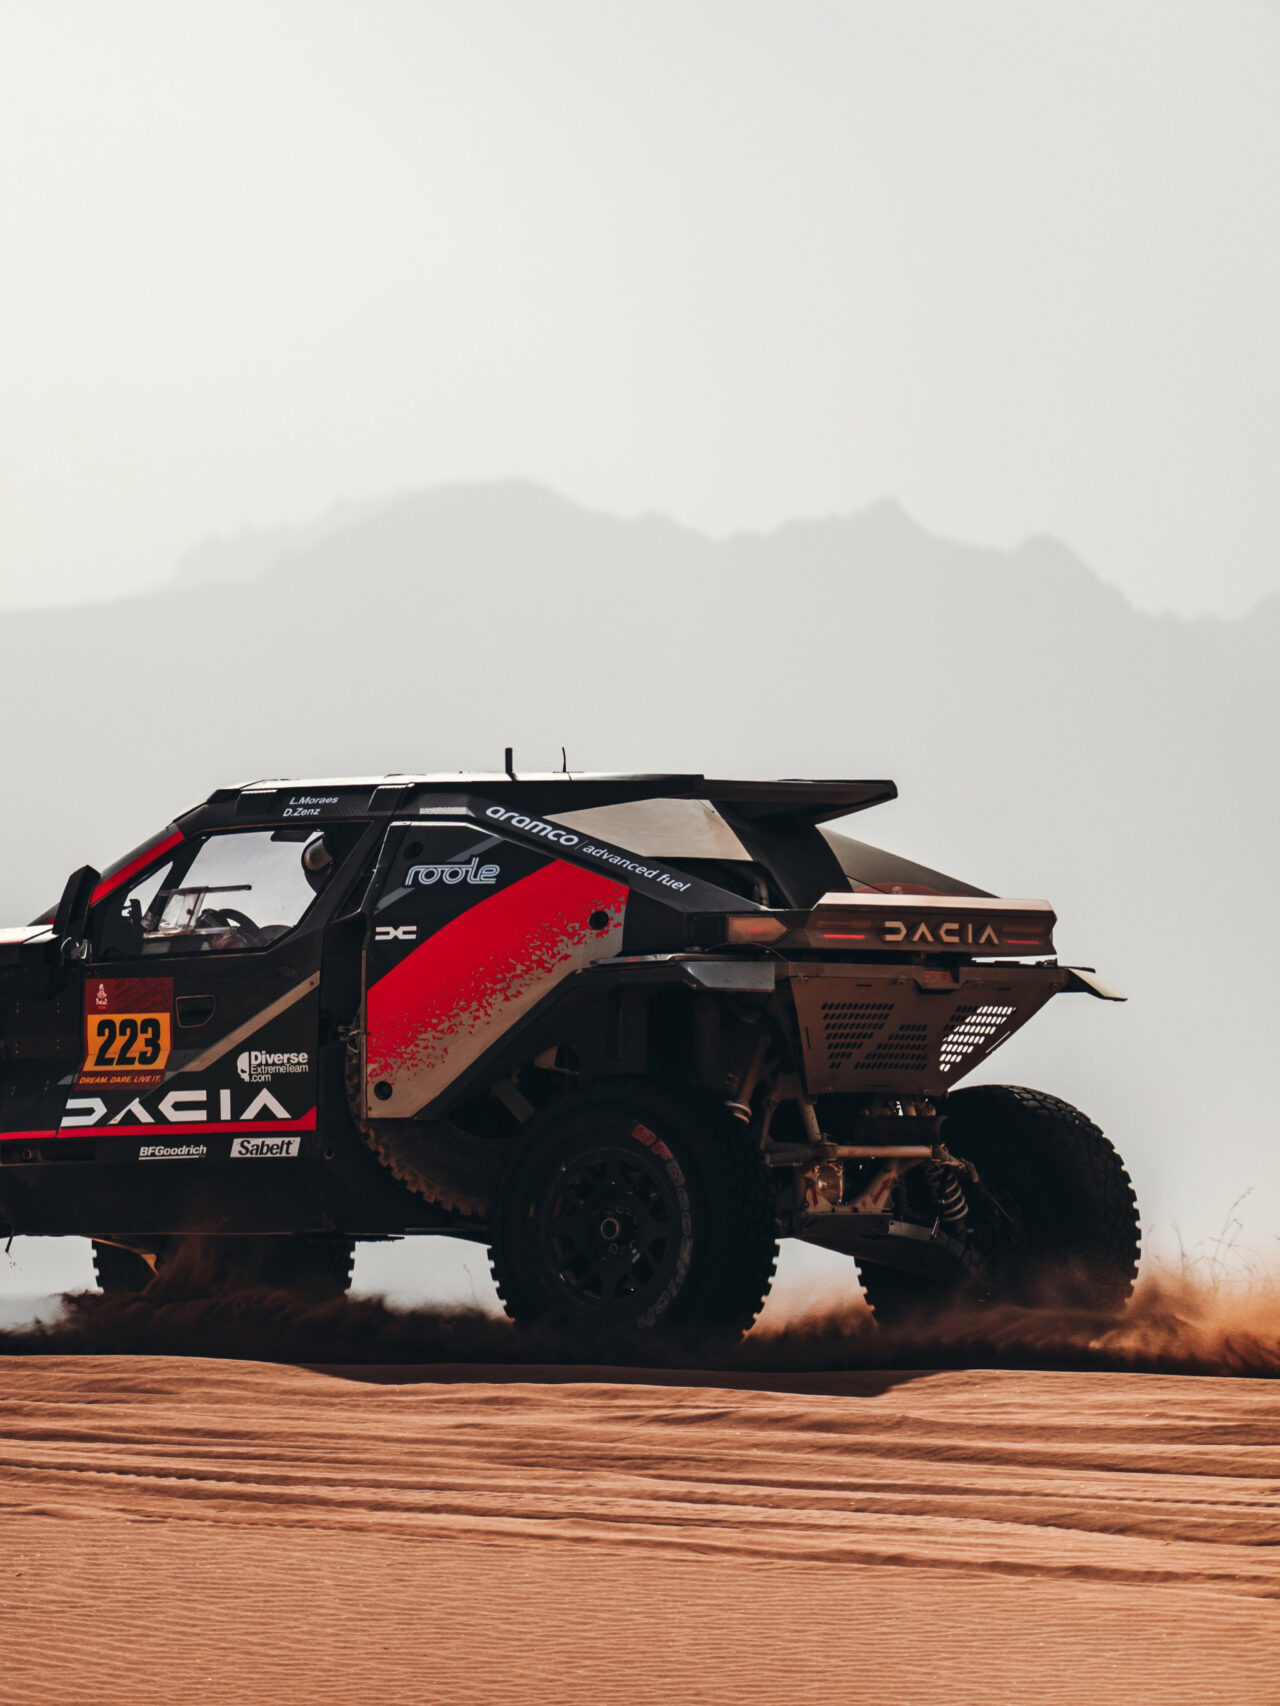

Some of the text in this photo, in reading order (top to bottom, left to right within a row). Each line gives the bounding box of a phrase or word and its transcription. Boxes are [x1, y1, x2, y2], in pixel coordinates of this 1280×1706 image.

[289, 795, 339, 805] L.Moraes
[282, 807, 320, 817] D.Zenz
[485, 805, 579, 846] aramco
[582, 843, 691, 892] advanced fuel
[882, 920, 1000, 945] DACIA
[94, 1017, 162, 1067] 223
[250, 1050, 309, 1065] Diverse
[250, 1064, 309, 1074] ExtremeTeam
[250, 1073, 272, 1082] .com
[60, 1087, 292, 1127] DACIA
[139, 1144, 207, 1157] BFGoodrich
[237, 1139, 292, 1157] Sabelt
